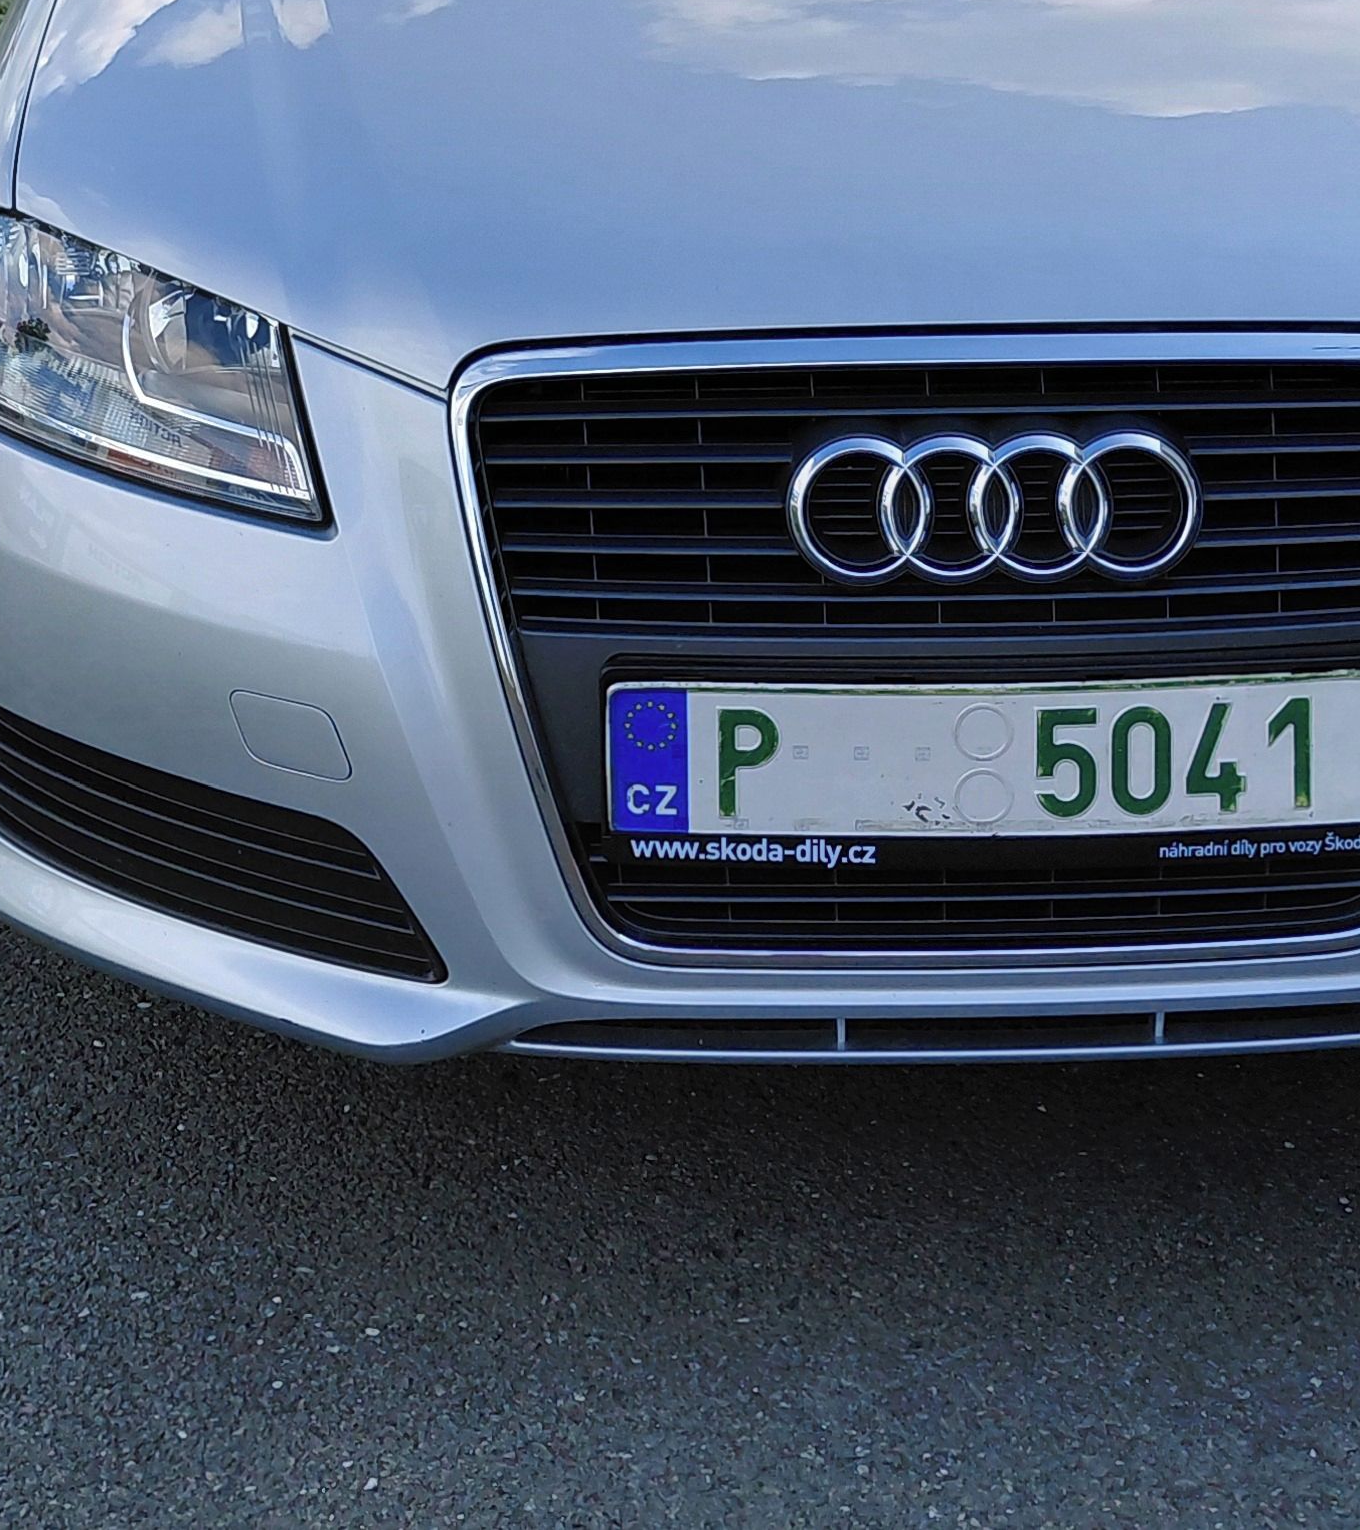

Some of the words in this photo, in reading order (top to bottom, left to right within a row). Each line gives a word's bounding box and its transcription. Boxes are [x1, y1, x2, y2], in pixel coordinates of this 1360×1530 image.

[717, 706, 781, 819] P
[1034, 696, 1313, 819] 5041
[626, 784, 678, 816] CZ
[630, 836, 877, 868] www.skoda-dily.cz
[1159, 840, 1228, 859] náhradní
[1260, 841, 1286, 858] pro
[1289, 839, 1323, 855] vozy
